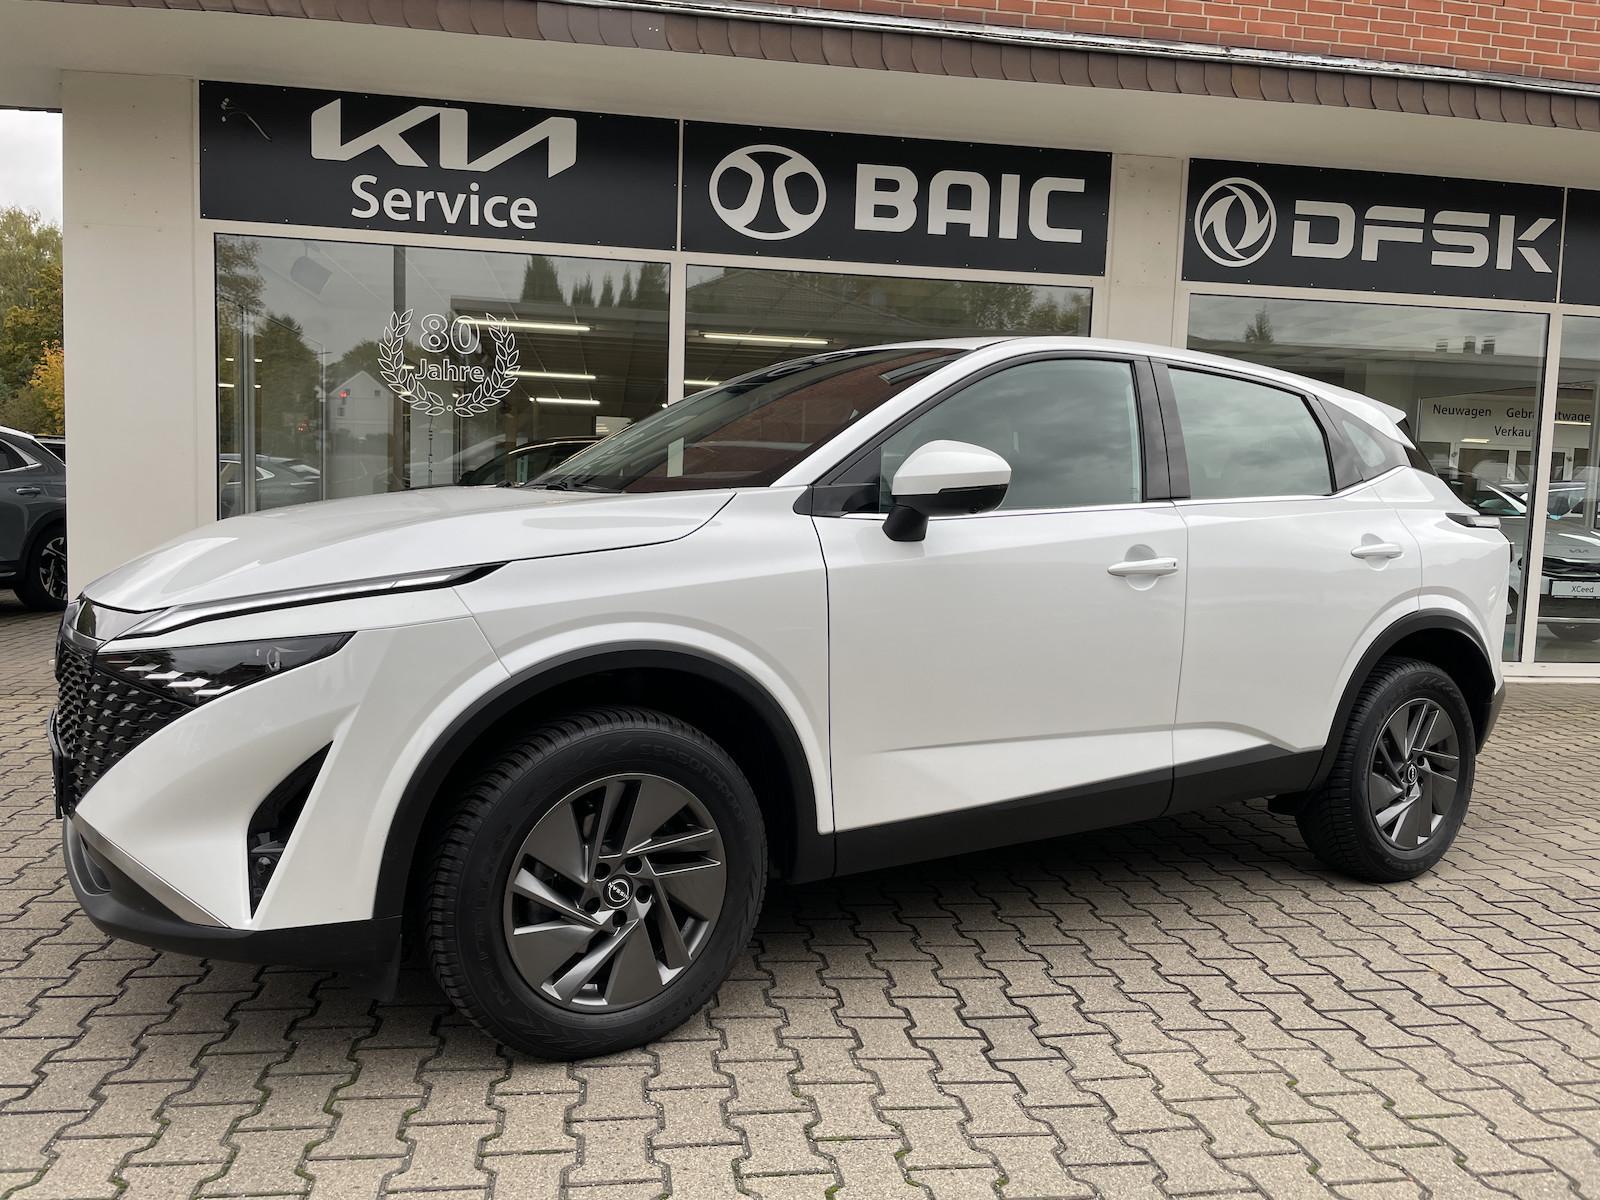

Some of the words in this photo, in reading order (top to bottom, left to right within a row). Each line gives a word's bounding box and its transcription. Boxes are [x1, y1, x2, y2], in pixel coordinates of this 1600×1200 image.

[350, 174, 538, 230] Service
[854, 163, 1085, 244] BAIC
[1291, 199, 1557, 274] DFSK
[419, 313, 481, 355] 80
[414, 358, 486, 383] Jahre
[1432, 403, 1492, 419] Neuwagen
[1494, 425, 1532, 438] Verkau
[1571, 585, 1595, 593] XCeed
